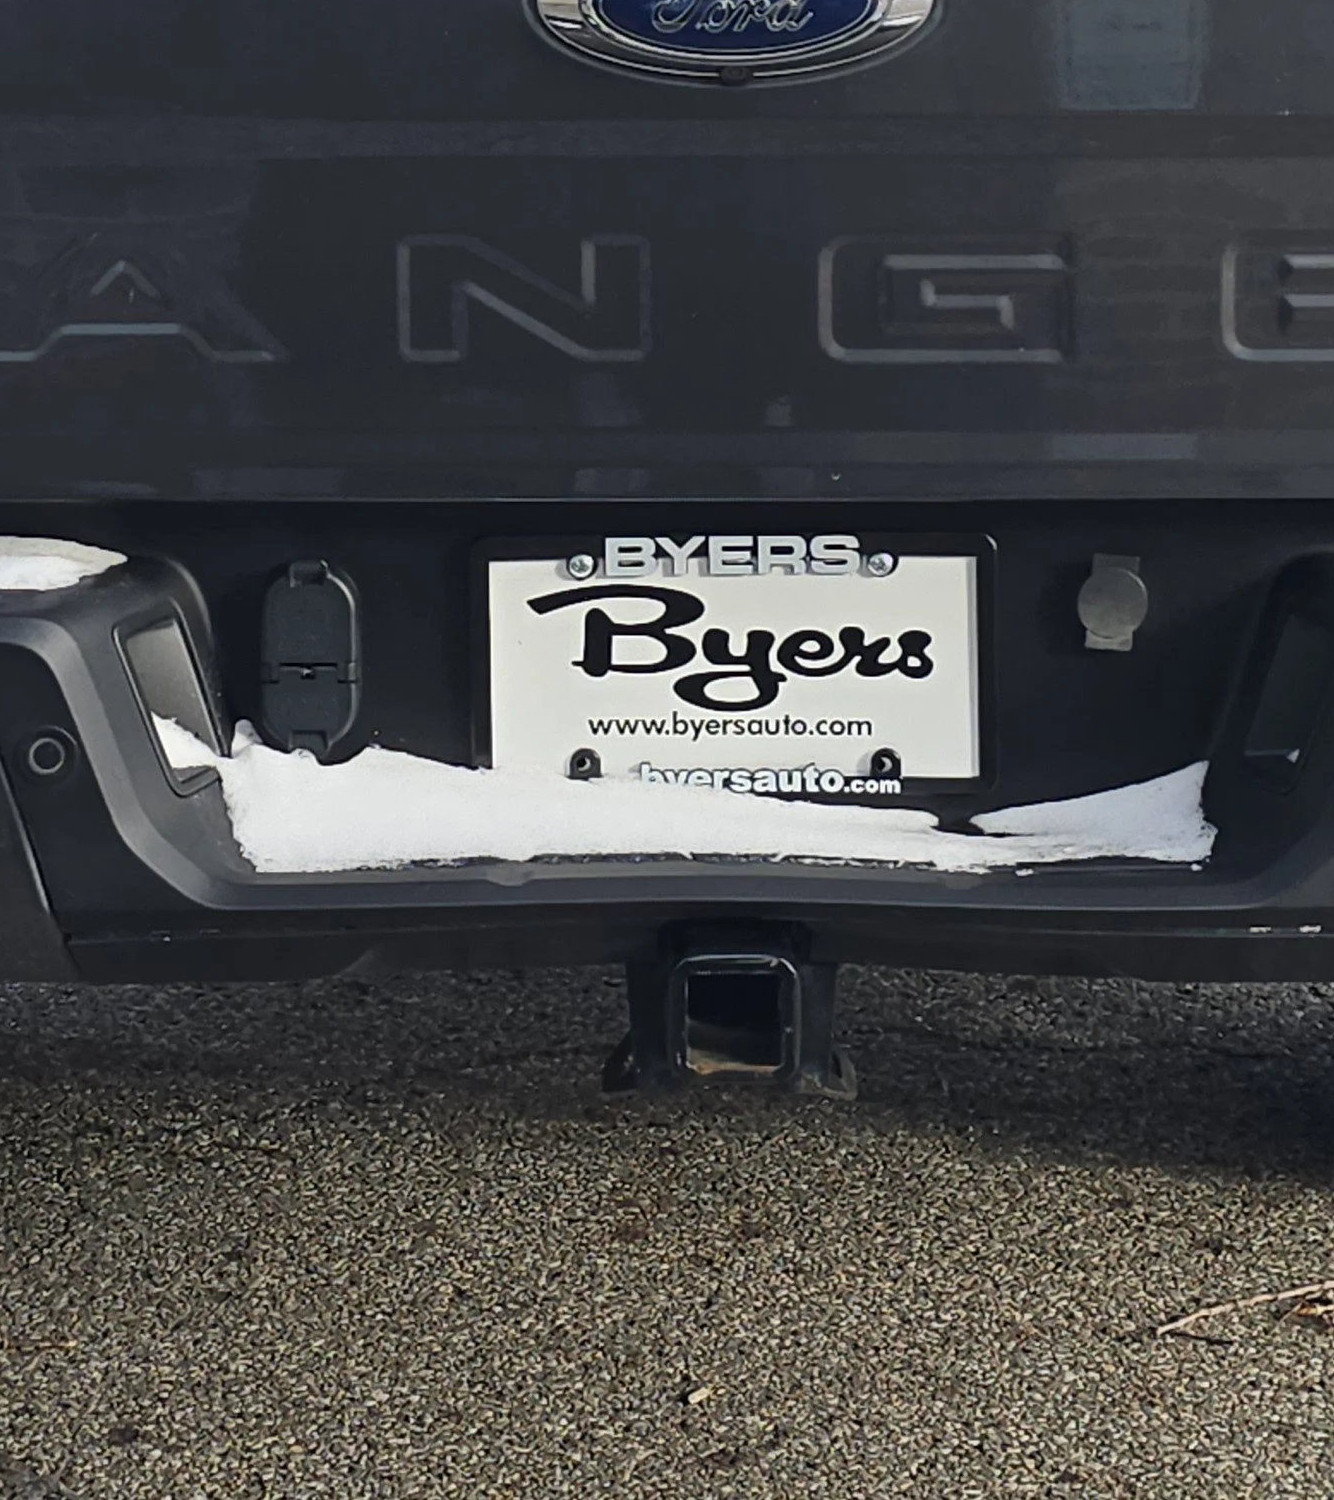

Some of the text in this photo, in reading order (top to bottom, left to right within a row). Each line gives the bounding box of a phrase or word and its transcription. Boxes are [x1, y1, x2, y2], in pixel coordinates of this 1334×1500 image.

[604, 534, 861, 577] BYERS
[527, 584, 933, 712] Byers
[588, 711, 873, 742] www.byersauto.com
